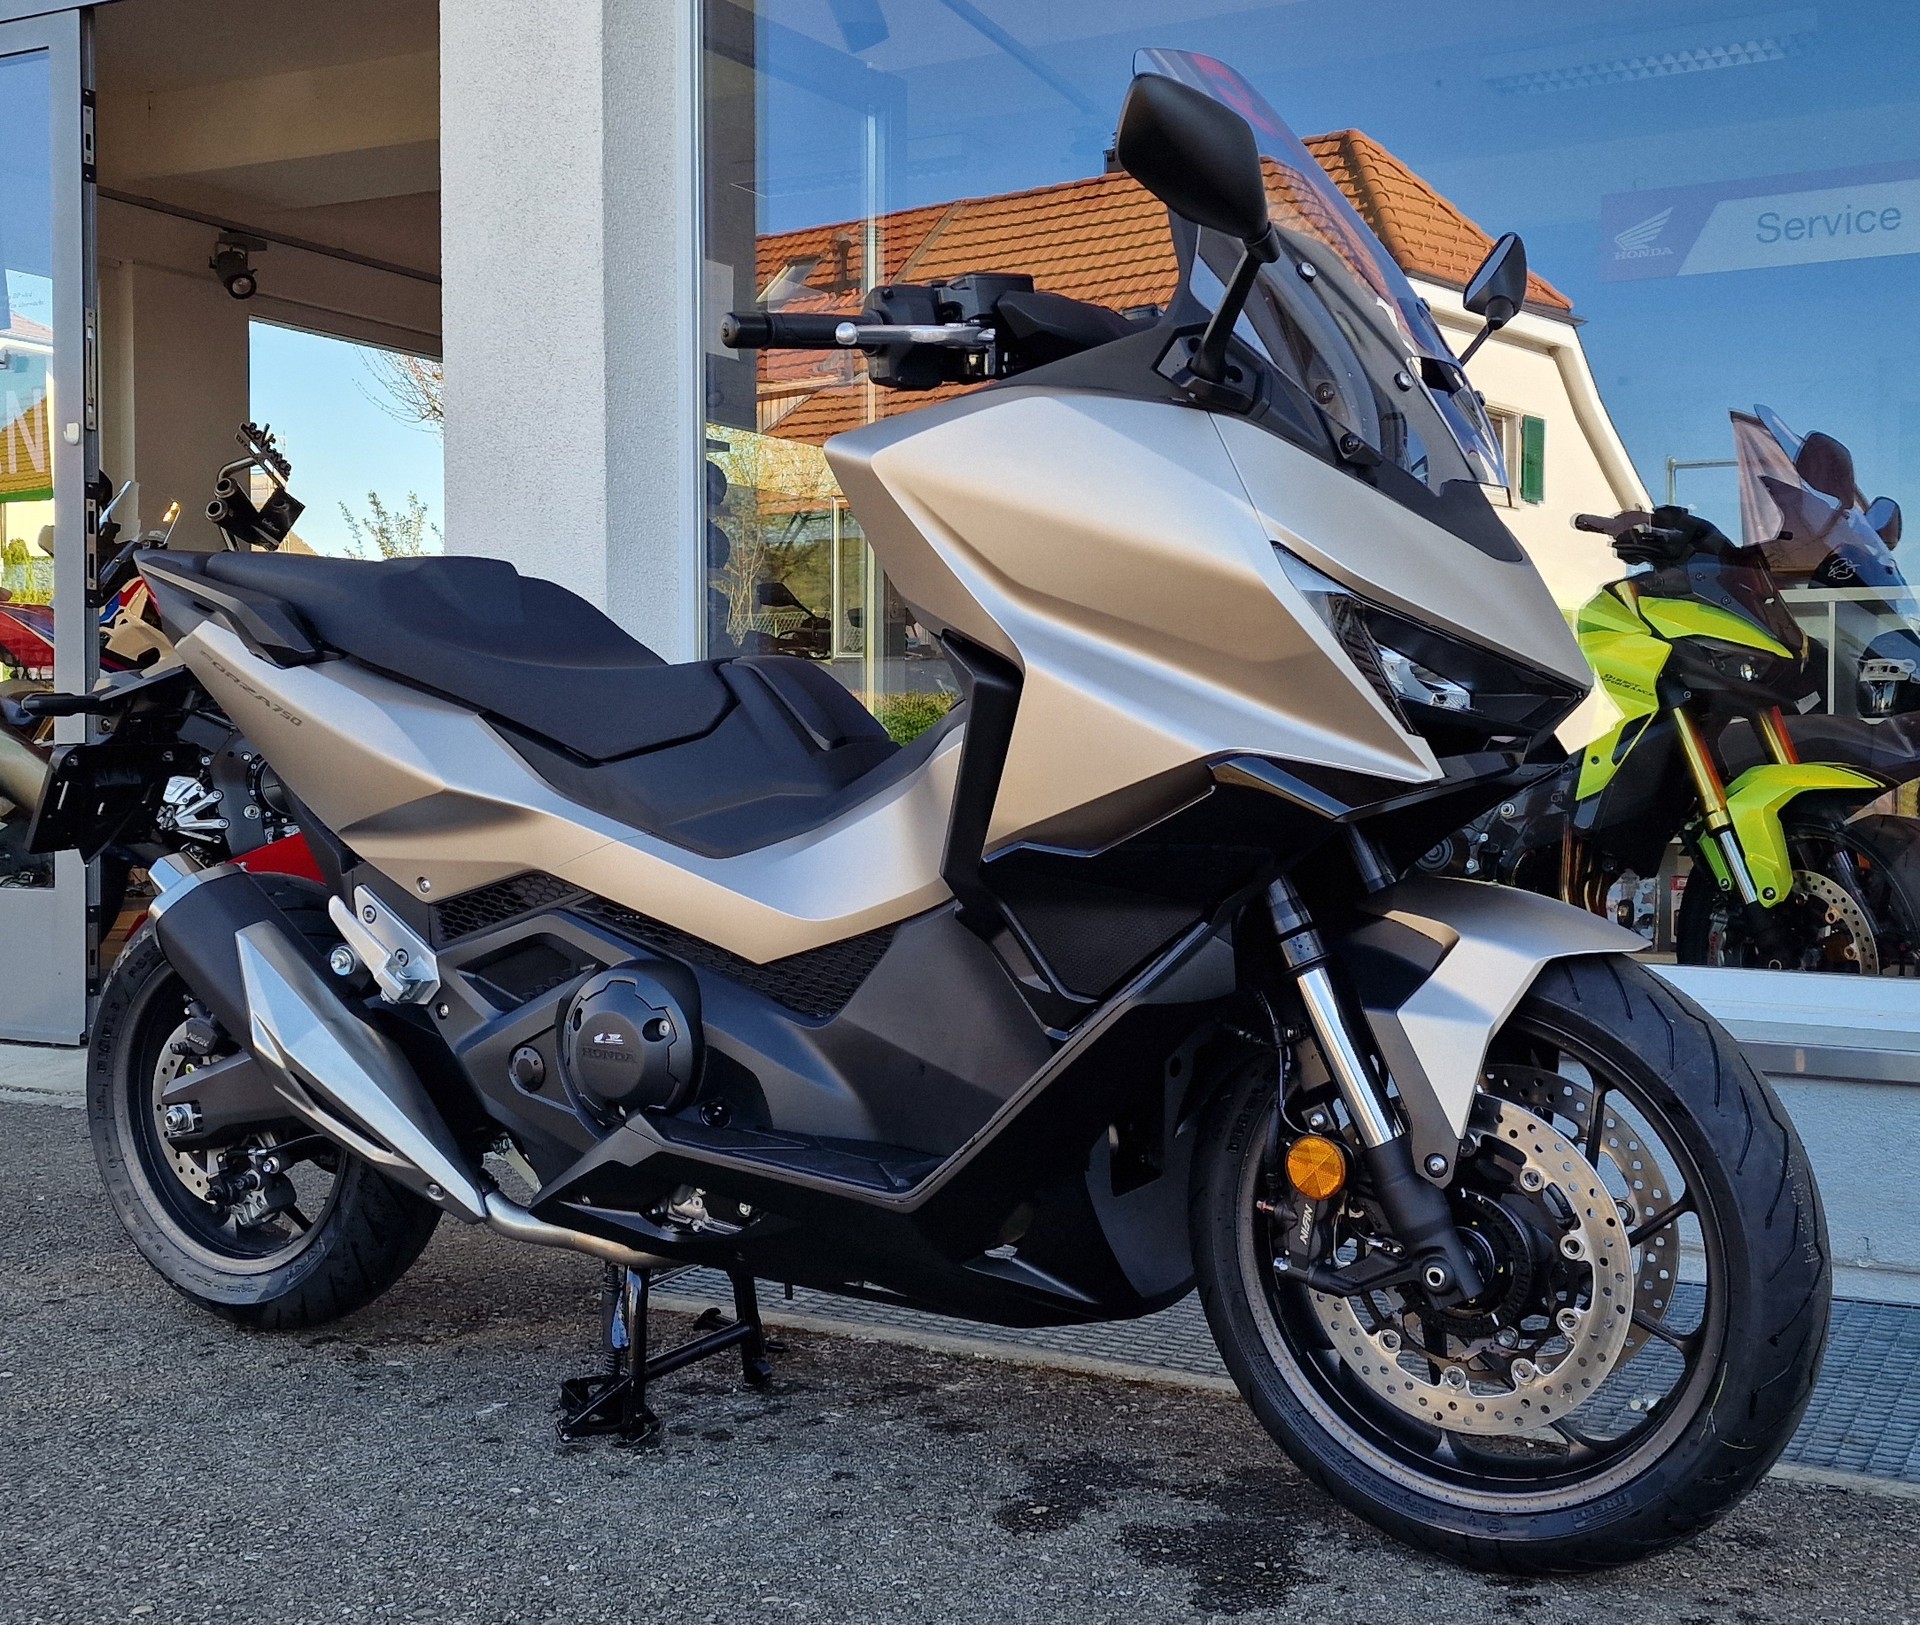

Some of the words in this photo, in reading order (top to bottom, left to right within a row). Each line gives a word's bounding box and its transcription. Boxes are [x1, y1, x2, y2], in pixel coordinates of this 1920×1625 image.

[1755, 204, 1902, 244] Service
[1614, 246, 1674, 261] HONDA
[0, 387, 46, 475] N
[581, 1046, 637, 1064] HONDA
